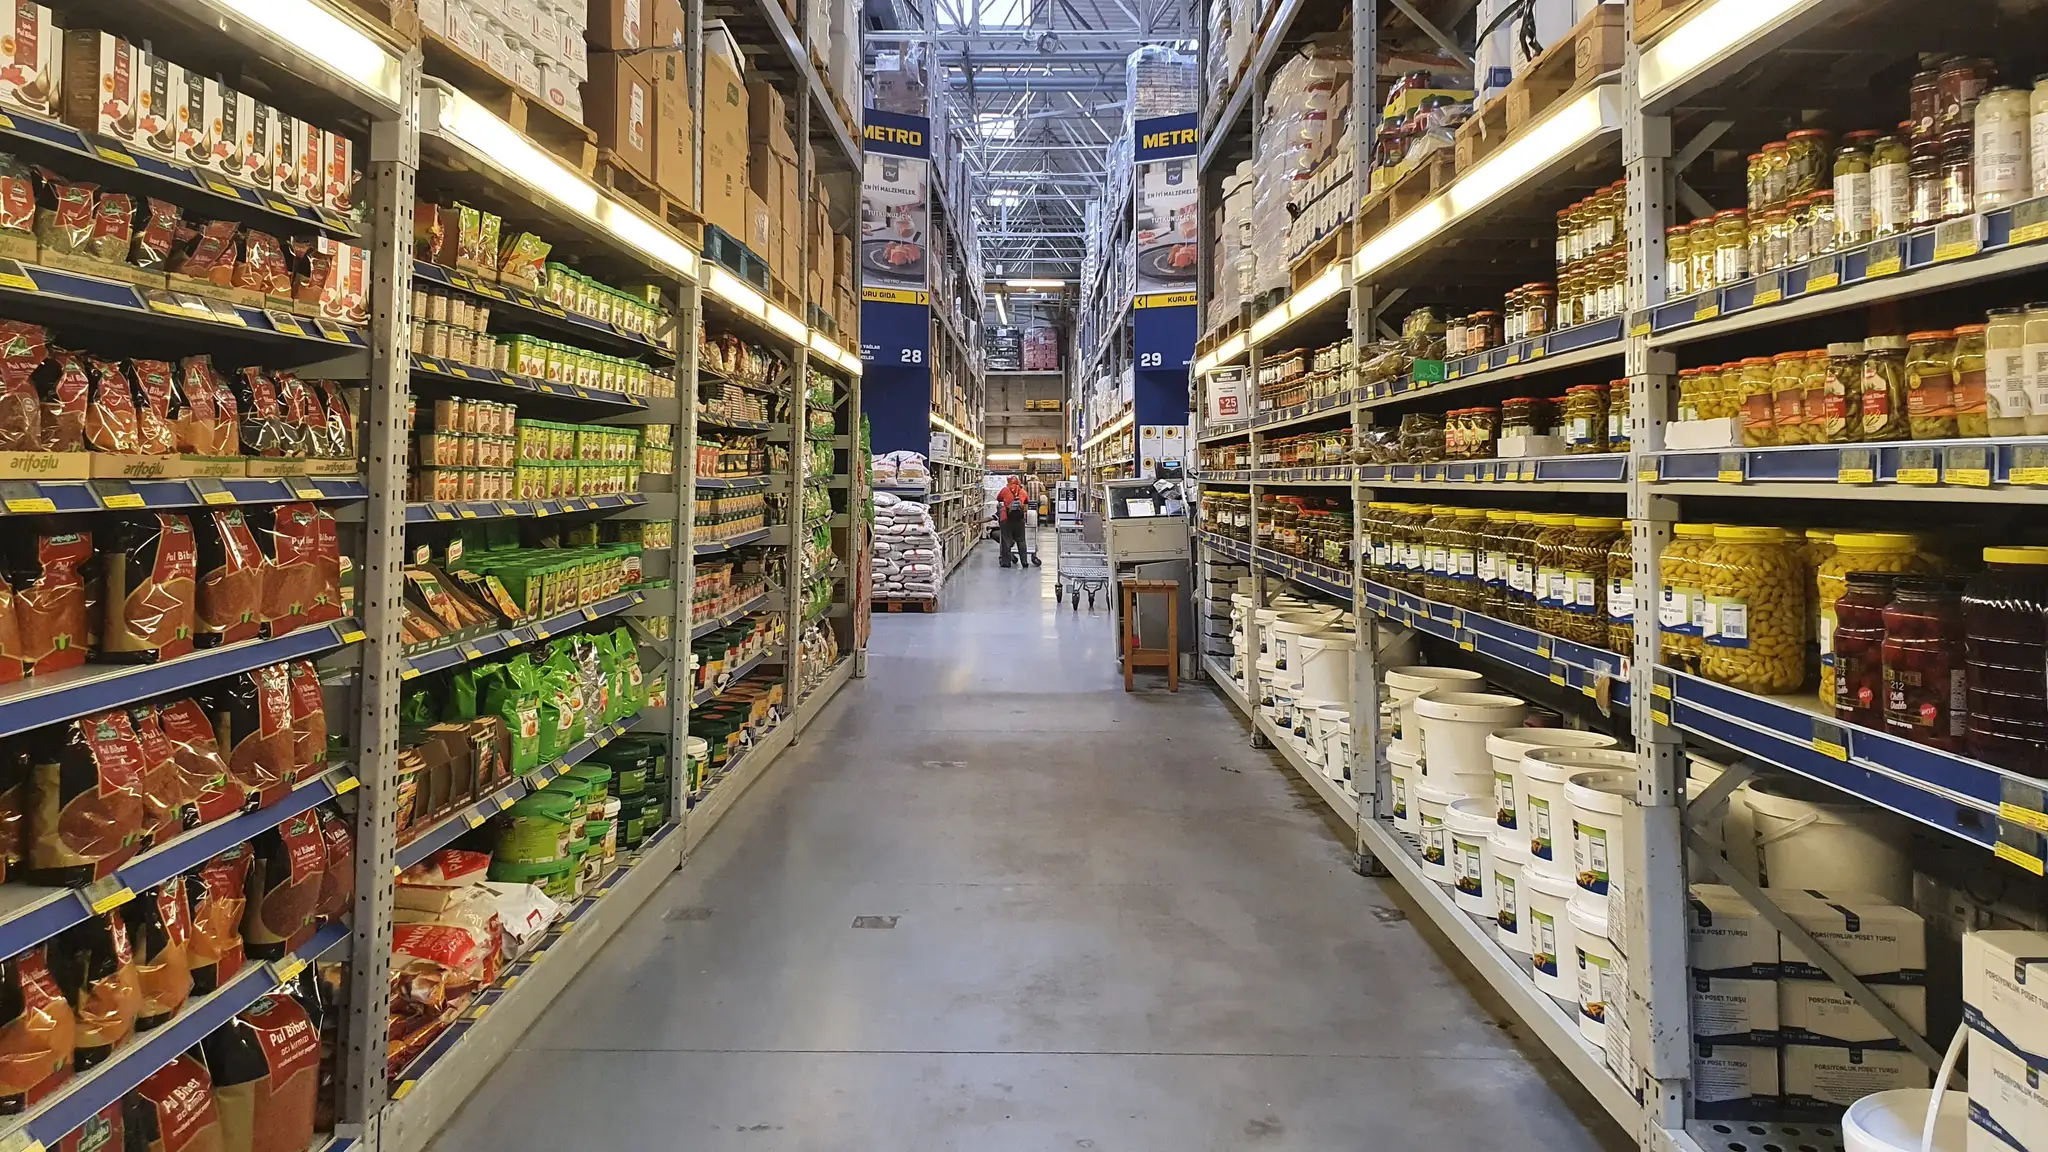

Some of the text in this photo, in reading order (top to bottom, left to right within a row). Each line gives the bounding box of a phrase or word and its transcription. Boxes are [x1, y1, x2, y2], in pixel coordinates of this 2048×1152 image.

[863, 124, 922, 146] METRO
[1163, 188, 1197, 197] MALZEMELE
[862, 290, 896, 299] URU GIDA
[1167, 295, 1187, 303] KURU
[901, 348, 922, 363] 28
[1140, 352, 1162, 367] 29
[10, 453, 59, 472] arifoğlu
[123, 461, 164, 477] arifoğlu
[166, 552, 176, 562] Pul
[1890, 680, 1904, 691] 212
[1860, 690, 1871, 698] HOT
[1921, 707, 1935, 716] HOT
[111, 744, 128, 754] Biber
[1706, 928, 1726, 937] POŞET
[1727, 929, 1748, 937] TURŞU
[1810, 930, 1897, 943] PORSİYONLUK POŞET TURŞU
[396, 925, 434, 955] PANKO
[1985, 968, 2020, 995] PORSİYONLUK
[2020, 987, 2038, 1005] POŞET
[1726, 996, 1747, 1004] TURŞU
[269, 1019, 308, 1047] Pul Biber
[1727, 1060, 1748, 1068] TURŞU
[1814, 1063, 1857, 1072] PORSİYONLUK
[1878, 1066, 1899, 1074] TURŞU
[1993, 1067, 2033, 1099] PORSİYONLUK
[162, 1078, 200, 1114] Pul Biber
